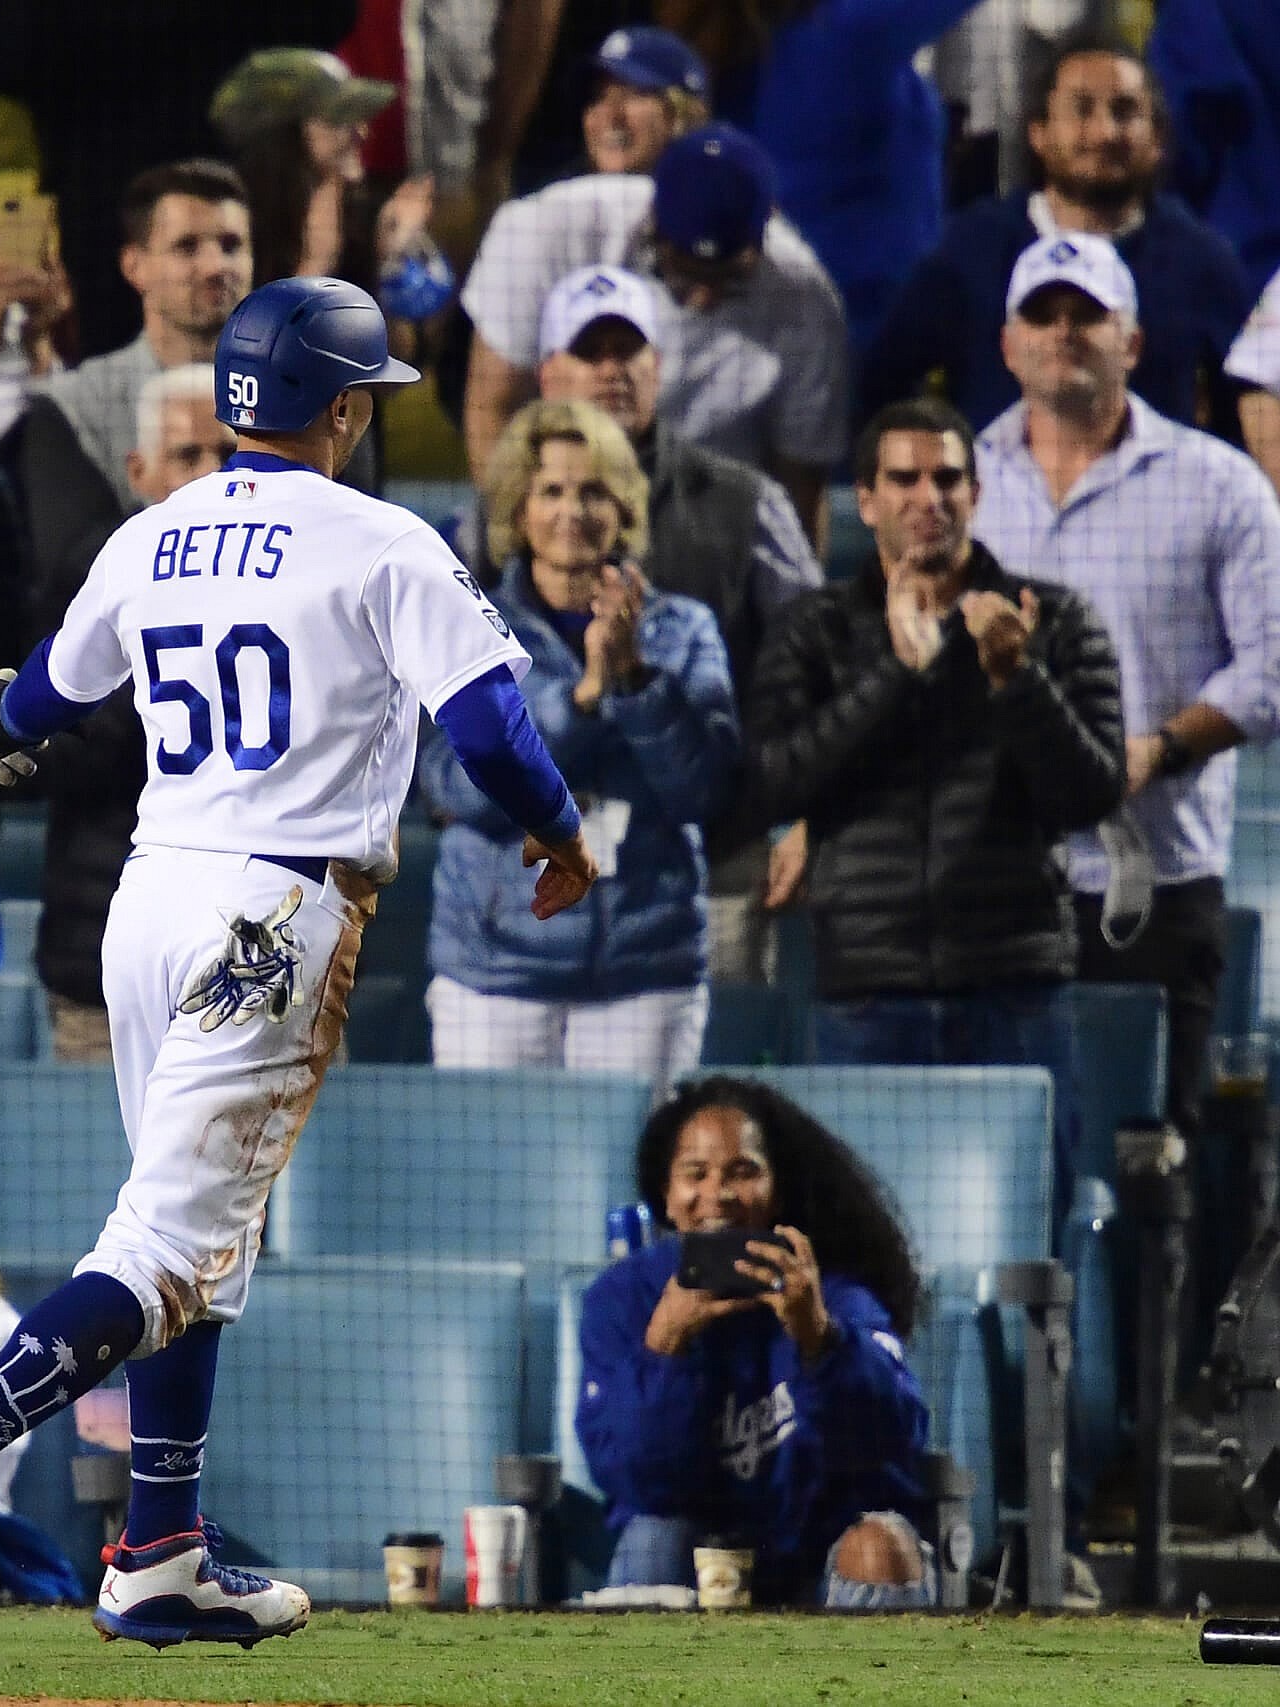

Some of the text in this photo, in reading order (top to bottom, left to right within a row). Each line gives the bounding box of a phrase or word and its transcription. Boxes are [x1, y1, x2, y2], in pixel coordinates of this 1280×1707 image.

[228, 371, 258, 408] 50
[153, 523, 293, 582] BETTS
[140, 623, 291, 776] 50
